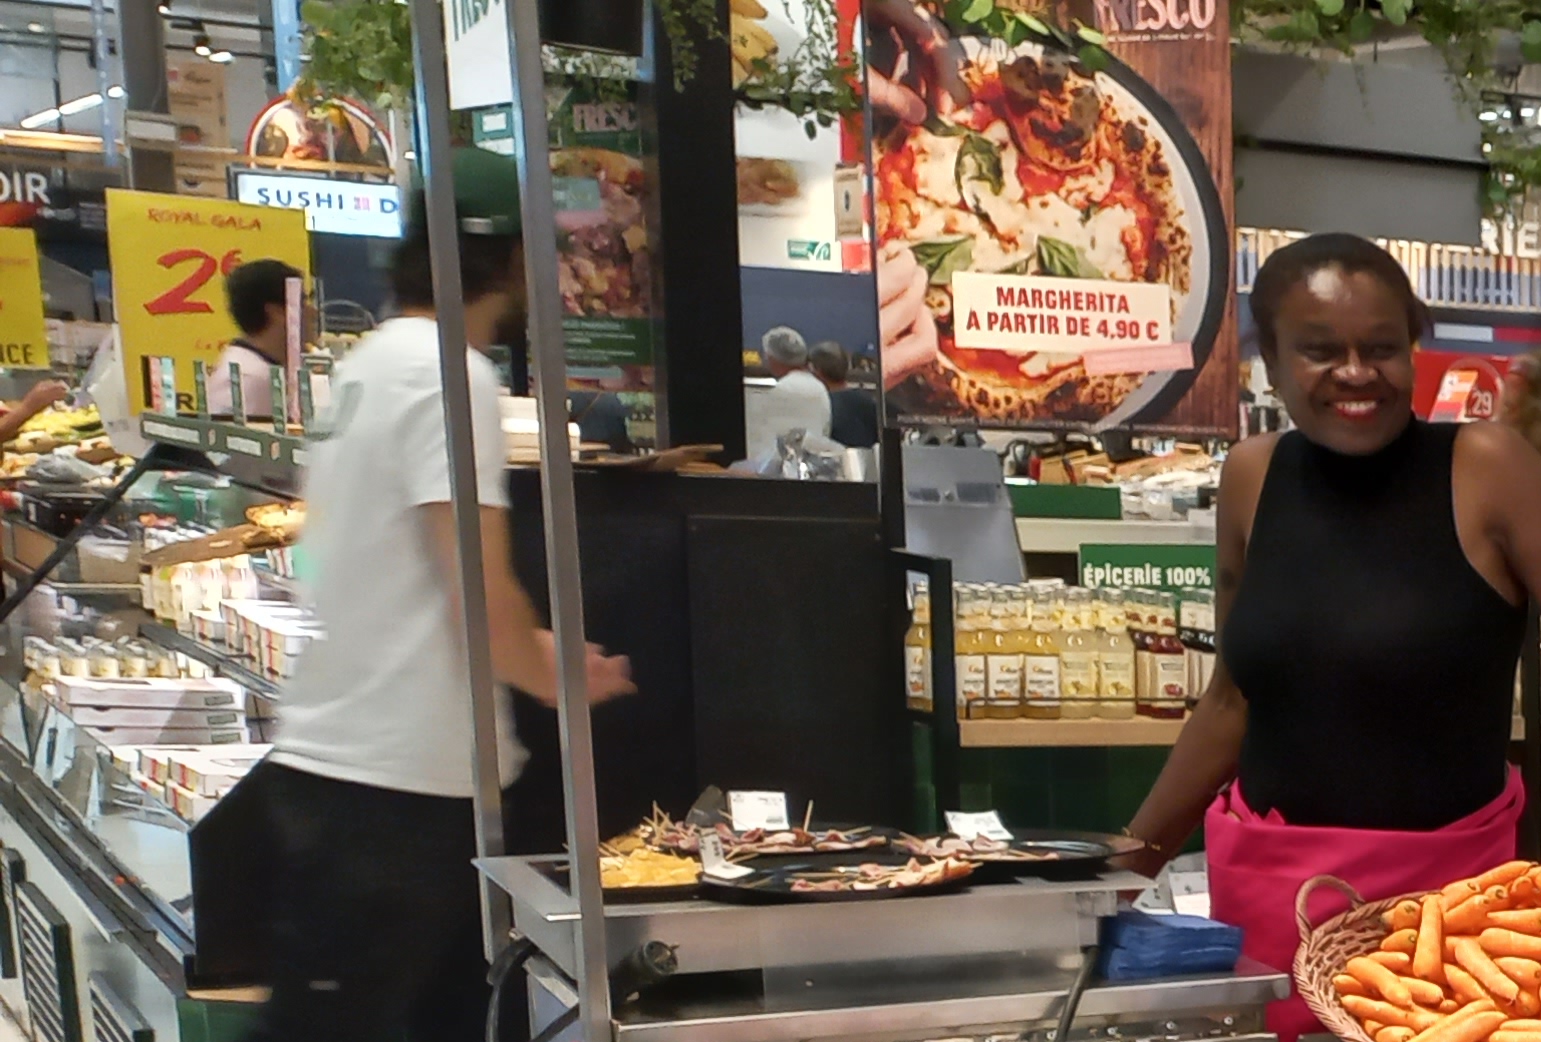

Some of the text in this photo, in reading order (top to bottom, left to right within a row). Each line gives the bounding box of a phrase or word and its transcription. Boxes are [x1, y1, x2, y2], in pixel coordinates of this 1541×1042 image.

[256, 187, 345, 211] SUSHI
[148, 207, 262, 232] ROYAL GALA
[996, 286, 1131, 314] MARGHERITA
[987, 312, 1060, 336] PARTIR
[1066, 317, 1091, 337] DE
[1165, 566, 1212, 587] 100%
